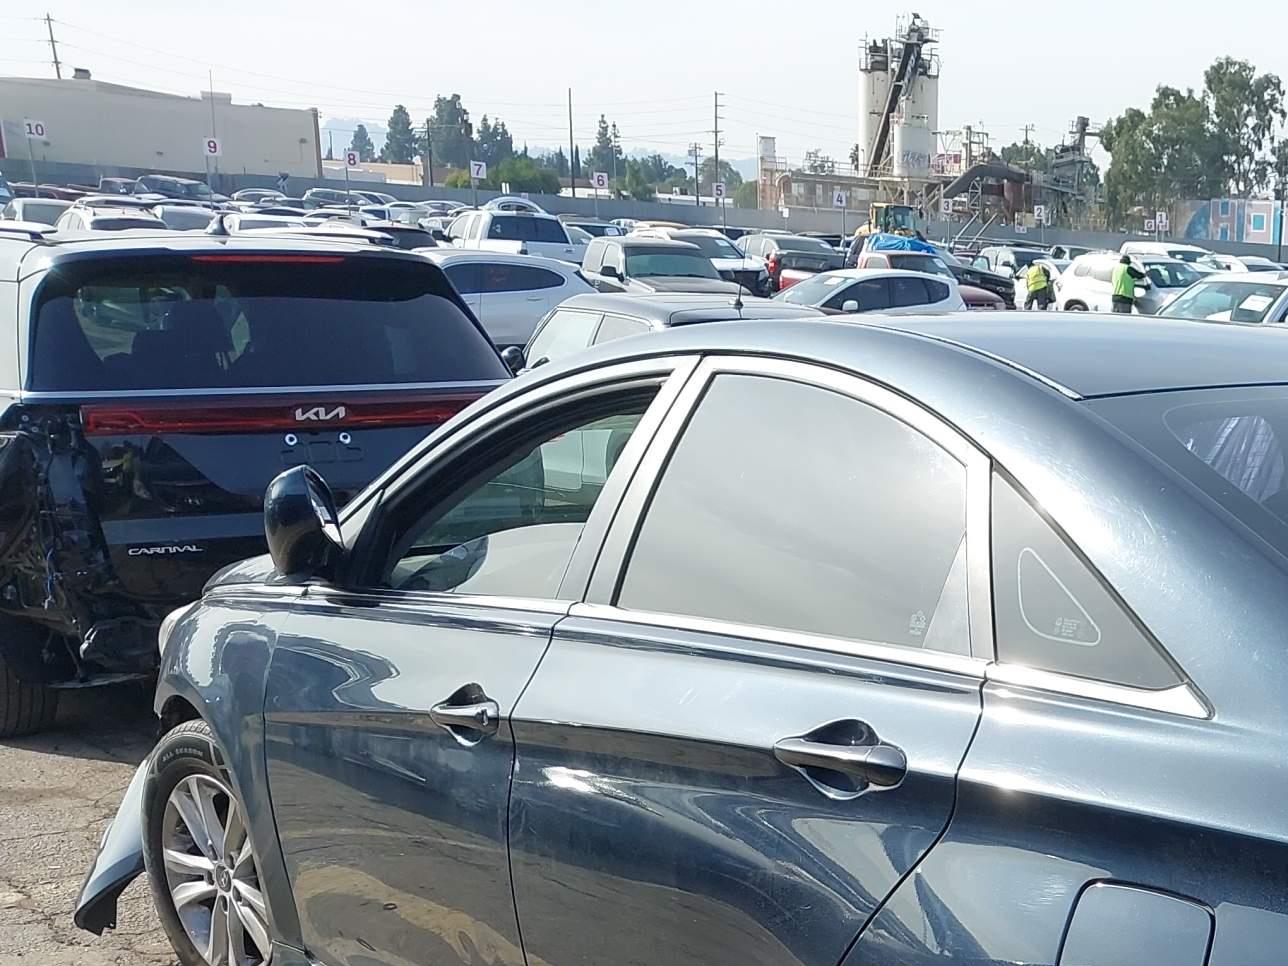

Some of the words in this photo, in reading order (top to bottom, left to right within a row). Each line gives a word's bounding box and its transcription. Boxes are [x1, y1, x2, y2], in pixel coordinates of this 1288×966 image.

[26, 122, 45, 137] 10
[207, 140, 217, 154] 9
[347, 153, 357, 166] 8
[473, 164, 483, 176] 7
[596, 174, 605, 187] 6
[715, 184, 723, 196] 5
[836, 193, 843, 204] 4
[944, 200, 950, 211] 3
[1036, 207, 1043, 218] 2
[1158, 213, 1164, 223] 1
[127, 544, 203, 556] CARNIVAL
